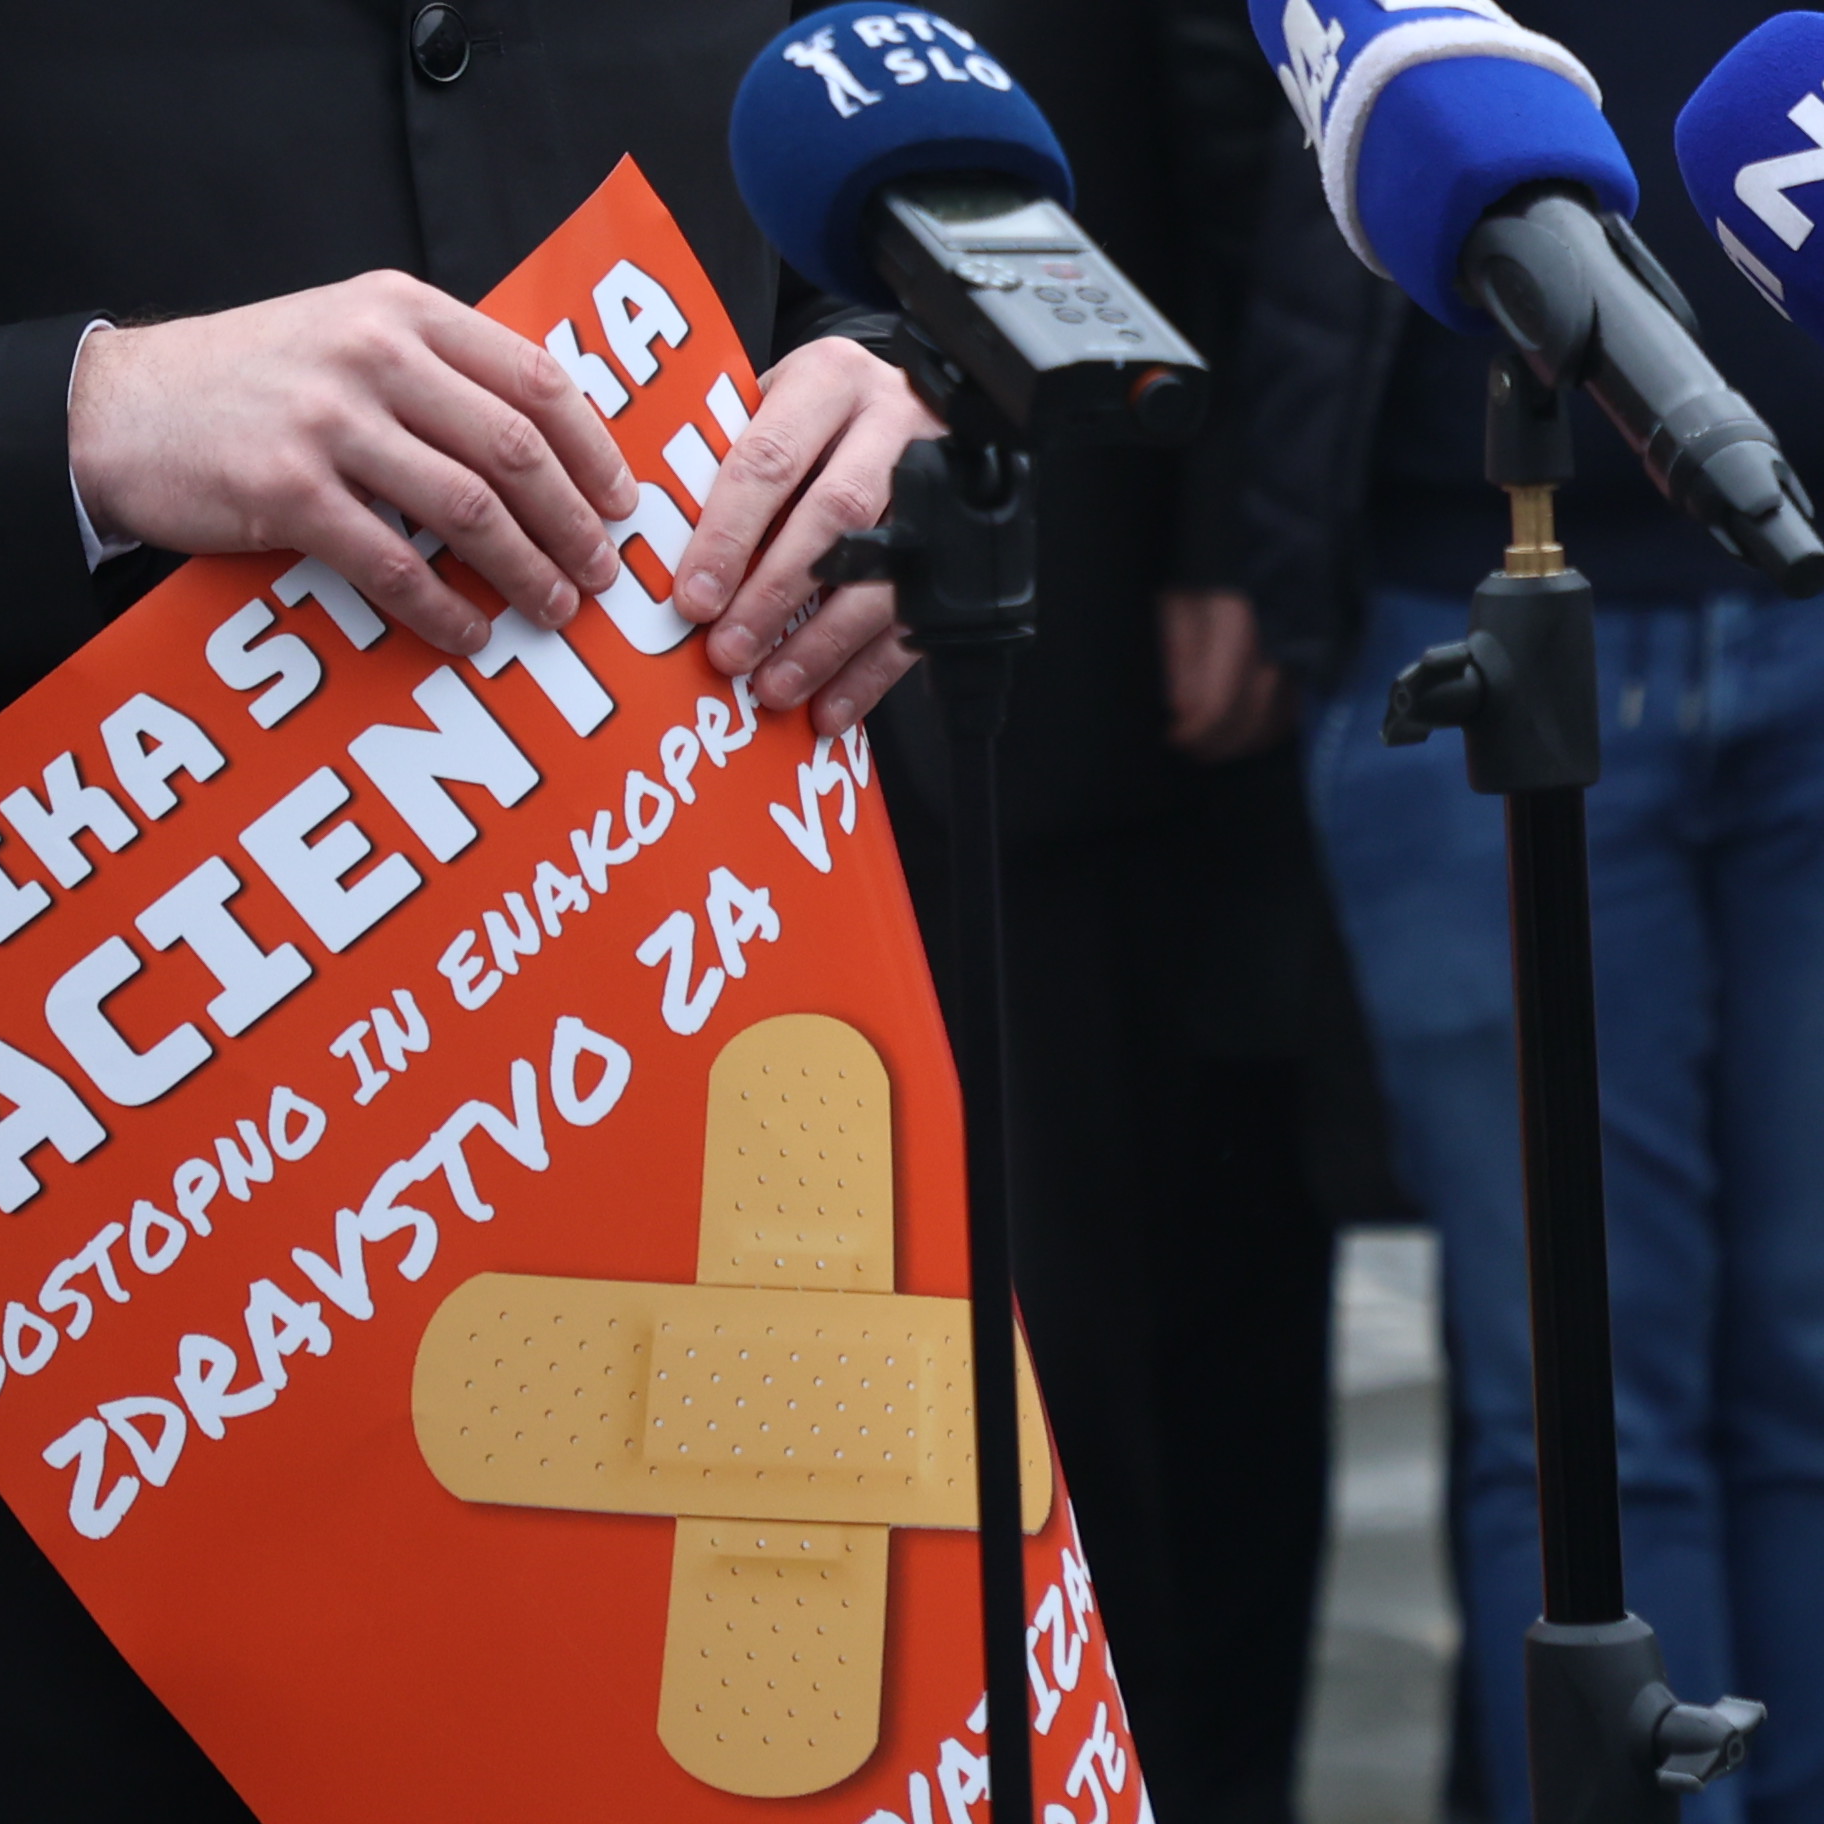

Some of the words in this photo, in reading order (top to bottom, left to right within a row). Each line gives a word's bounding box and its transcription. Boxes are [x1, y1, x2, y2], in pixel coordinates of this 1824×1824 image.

[884, 47, 1013, 91] SLO
[204, 259, 689, 729] STKA
[330, 989, 430, 1105] IN
[42, 1015, 632, 1539] ZDRAVSTVO
[636, 867, 781, 1035] ZA
